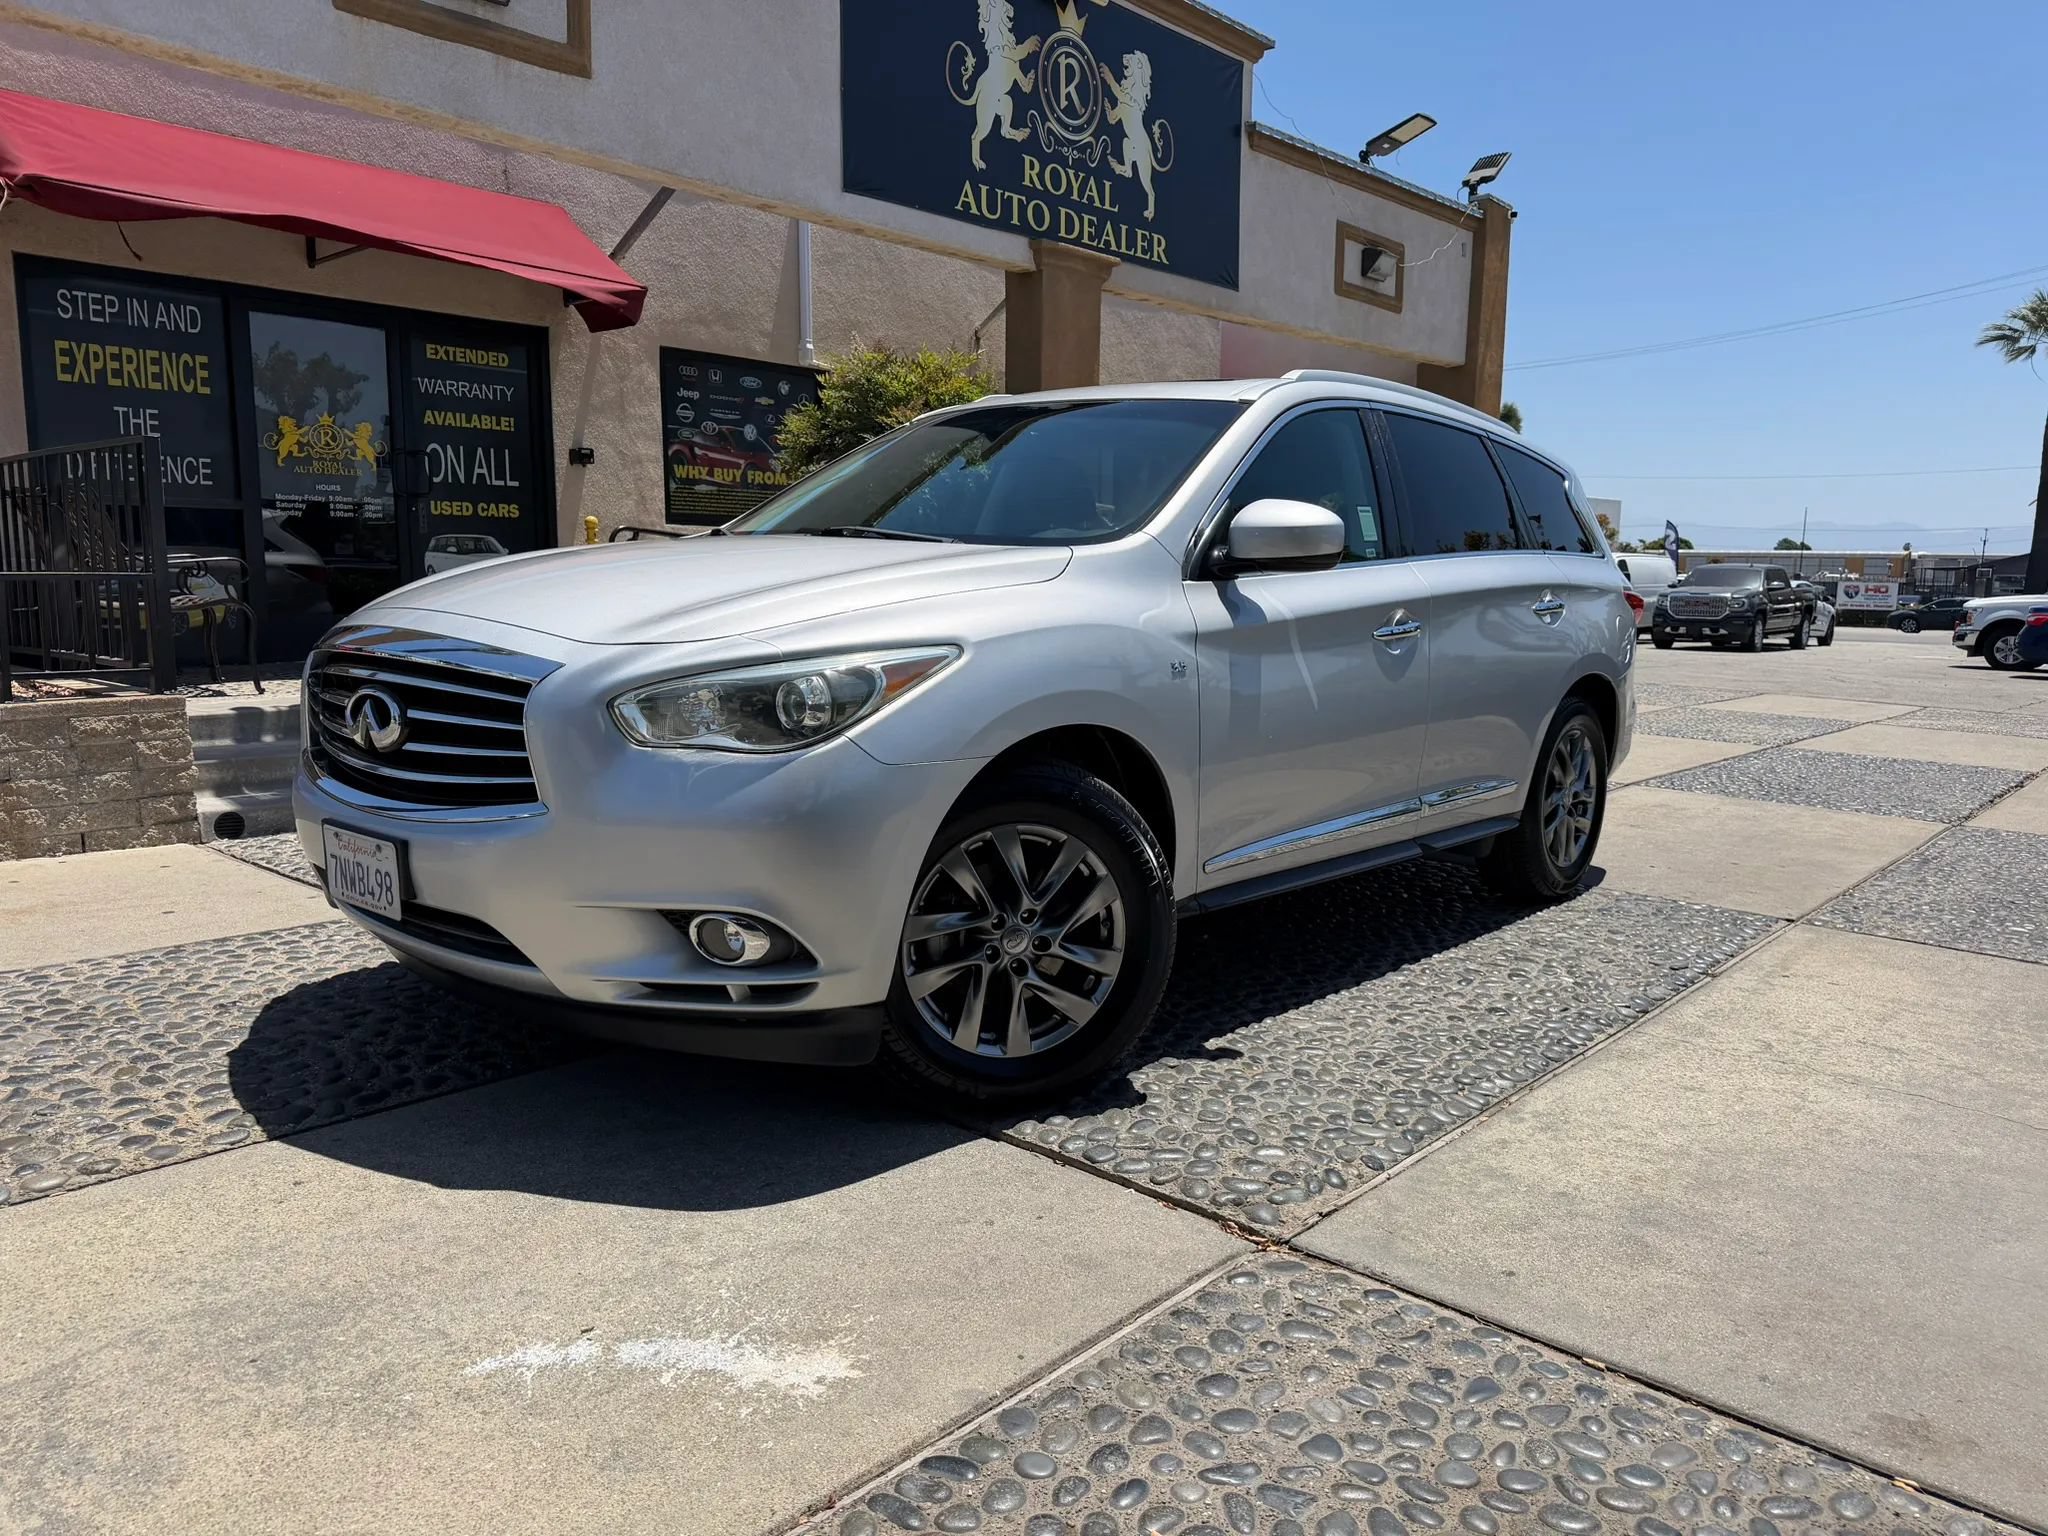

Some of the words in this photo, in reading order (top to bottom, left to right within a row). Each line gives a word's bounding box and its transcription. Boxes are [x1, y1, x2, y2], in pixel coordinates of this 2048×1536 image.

[1058, 53, 1085, 116] R
[1022, 154, 1119, 212] ROYAL
[954, 180, 1050, 232] AUTO
[1058, 206, 1169, 265] DEALER
[56, 289, 119, 323] STEP
[126, 297, 149, 328] IN
[155, 301, 201, 333] AND
[54, 339, 211, 394] EXPERIENCE
[426, 343, 509, 367] EXTENDED
[417, 376, 515, 401] WARRANTY
[677, 387, 700, 400] Jeep
[113, 406, 161, 437] THE
[423, 409, 515, 431] AVAILABLE!
[320, 429, 334, 446] R
[293, 465, 321, 474] AUTO
[325, 466, 363, 476] DEALER
[312, 460, 344, 469] ROYAL
[425, 443, 465, 484] ON
[472, 446, 519, 487] ALL
[674, 464, 710, 480] WHY
[714, 467, 742, 482] BUY
[748, 471, 787, 486] FROM
[275, 493, 326, 502] Monday-Friday
[315, 484, 342, 492] HOURS
[276, 502, 307, 510] Saturday
[430, 500, 473, 517] USED
[477, 502, 520, 518] CARS
[330, 853, 394, 907] 7NWB498
